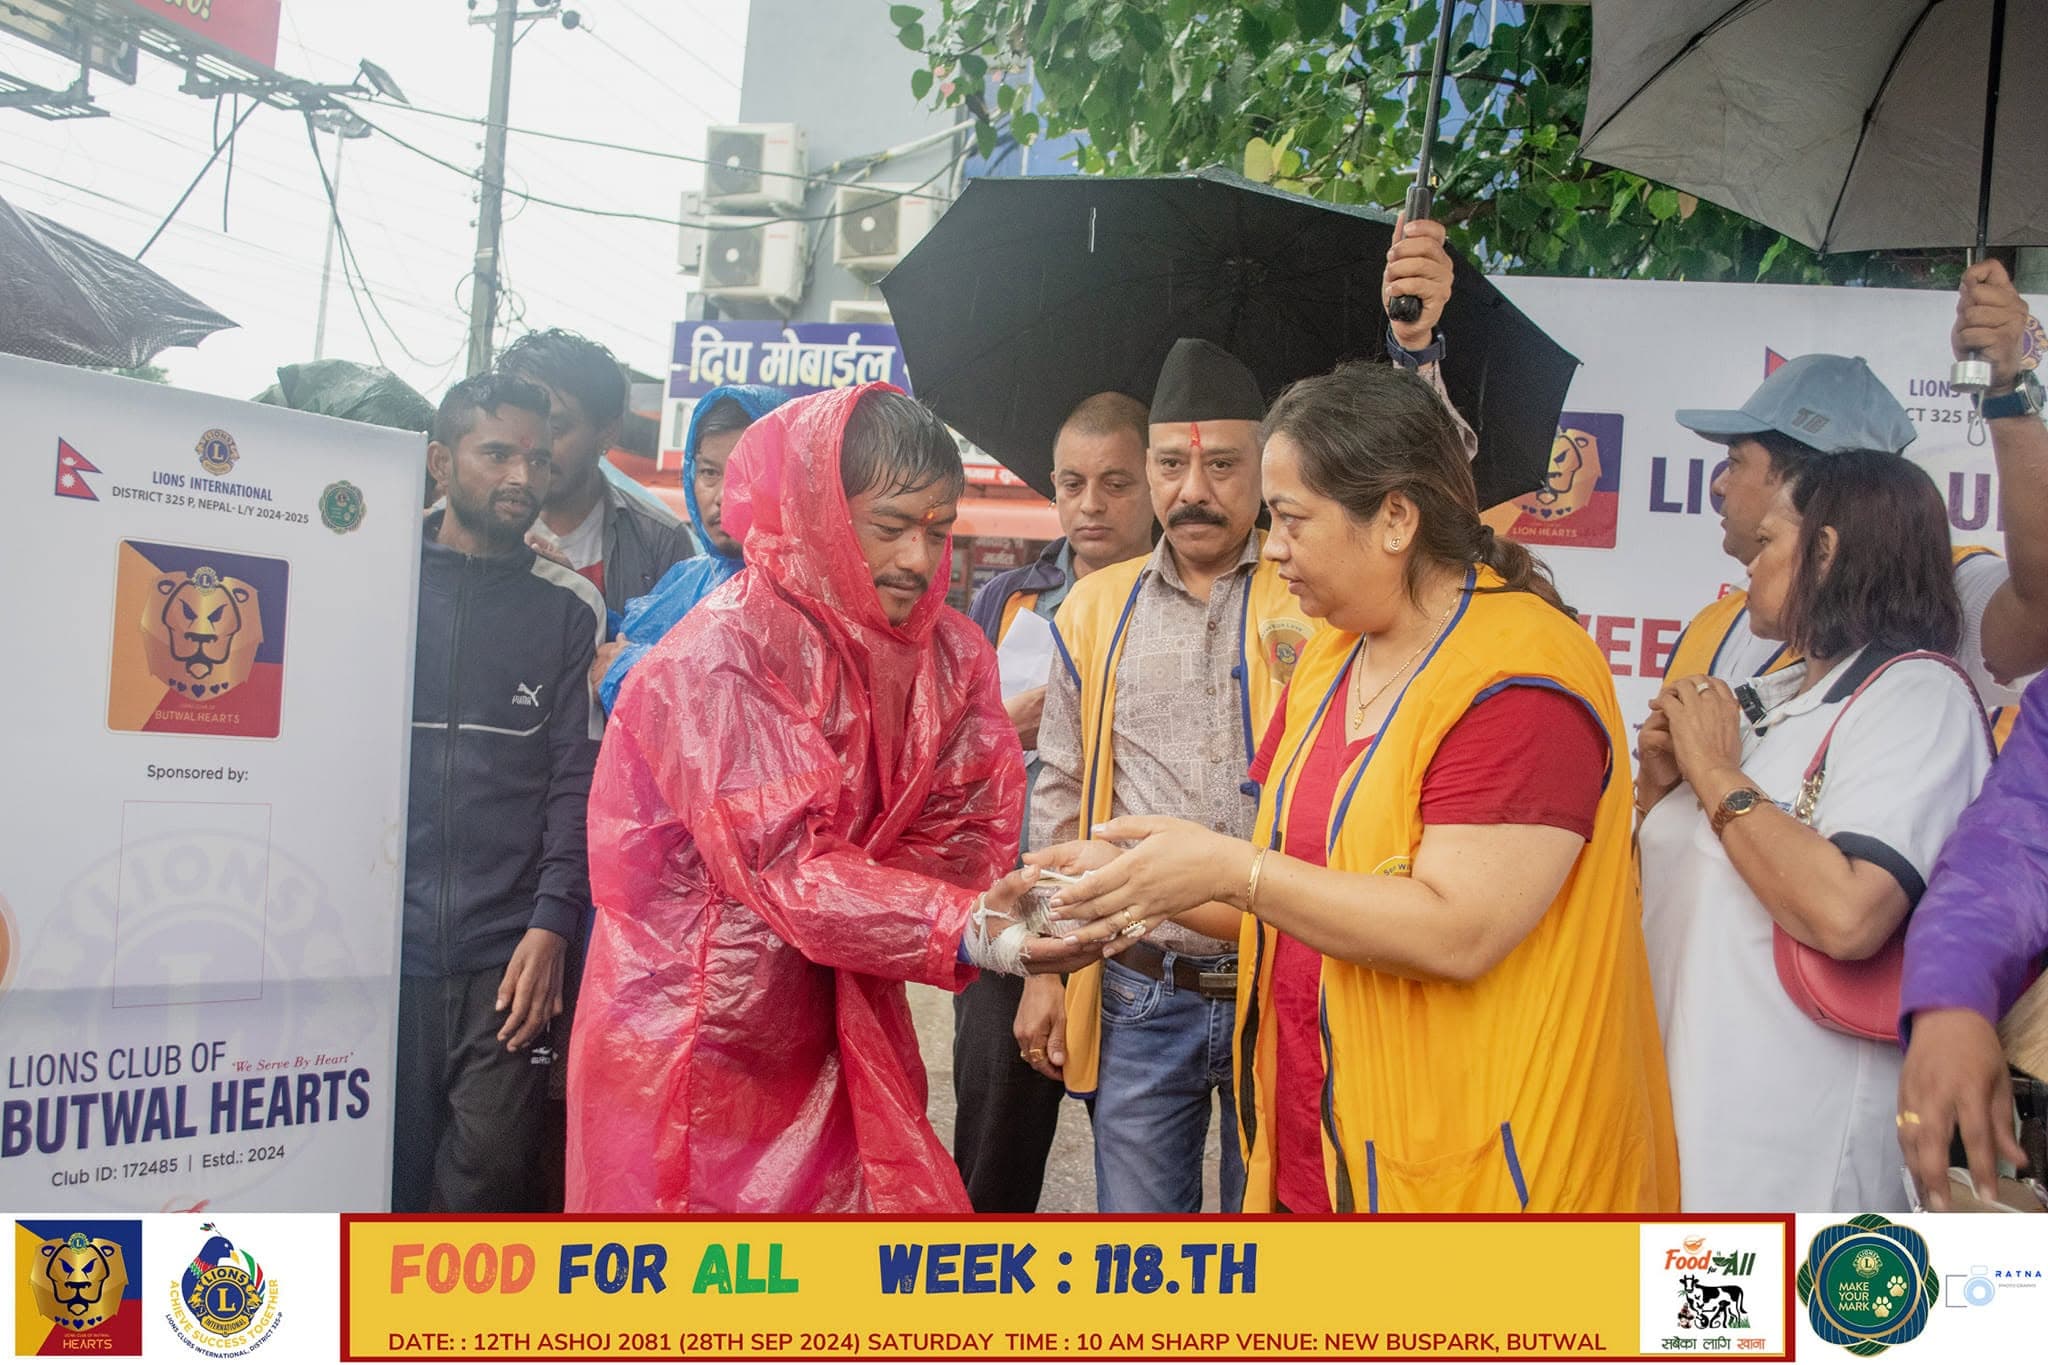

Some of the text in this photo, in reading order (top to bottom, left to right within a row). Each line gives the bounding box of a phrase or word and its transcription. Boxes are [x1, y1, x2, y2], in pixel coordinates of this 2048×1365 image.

[689, 326, 896, 388] दिप मोबाईल
[1930, 408, 1962, 423] 325
[152, 471, 272, 501] LIONS INTERNATIONAL
[112, 486, 163, 503] DISTRICT
[165, 494, 185, 506] 325
[238, 506, 255, 516] L/Y
[256, 507, 310, 524] 2024-2025
[1513, 526, 1578, 538] LION HEARTS
[155, 710, 240, 724] BUTWAL HEARTS
[147, 764, 249, 783] Sponsored by:
[8, 1040, 226, 1089] LIONS CLUB OF
[256, 1059, 290, 1071] Serve
[294, 1056, 311, 1070] By
[1, 1067, 370, 1158] BUTWAL HEARTS
[51, 1167, 90, 1187] Club
[96, 1164, 118, 1182] ID:
[122, 1158, 178, 1177] 172485
[202, 1149, 244, 1169] Estd.:
[248, 1144, 286, 1163] 2024
